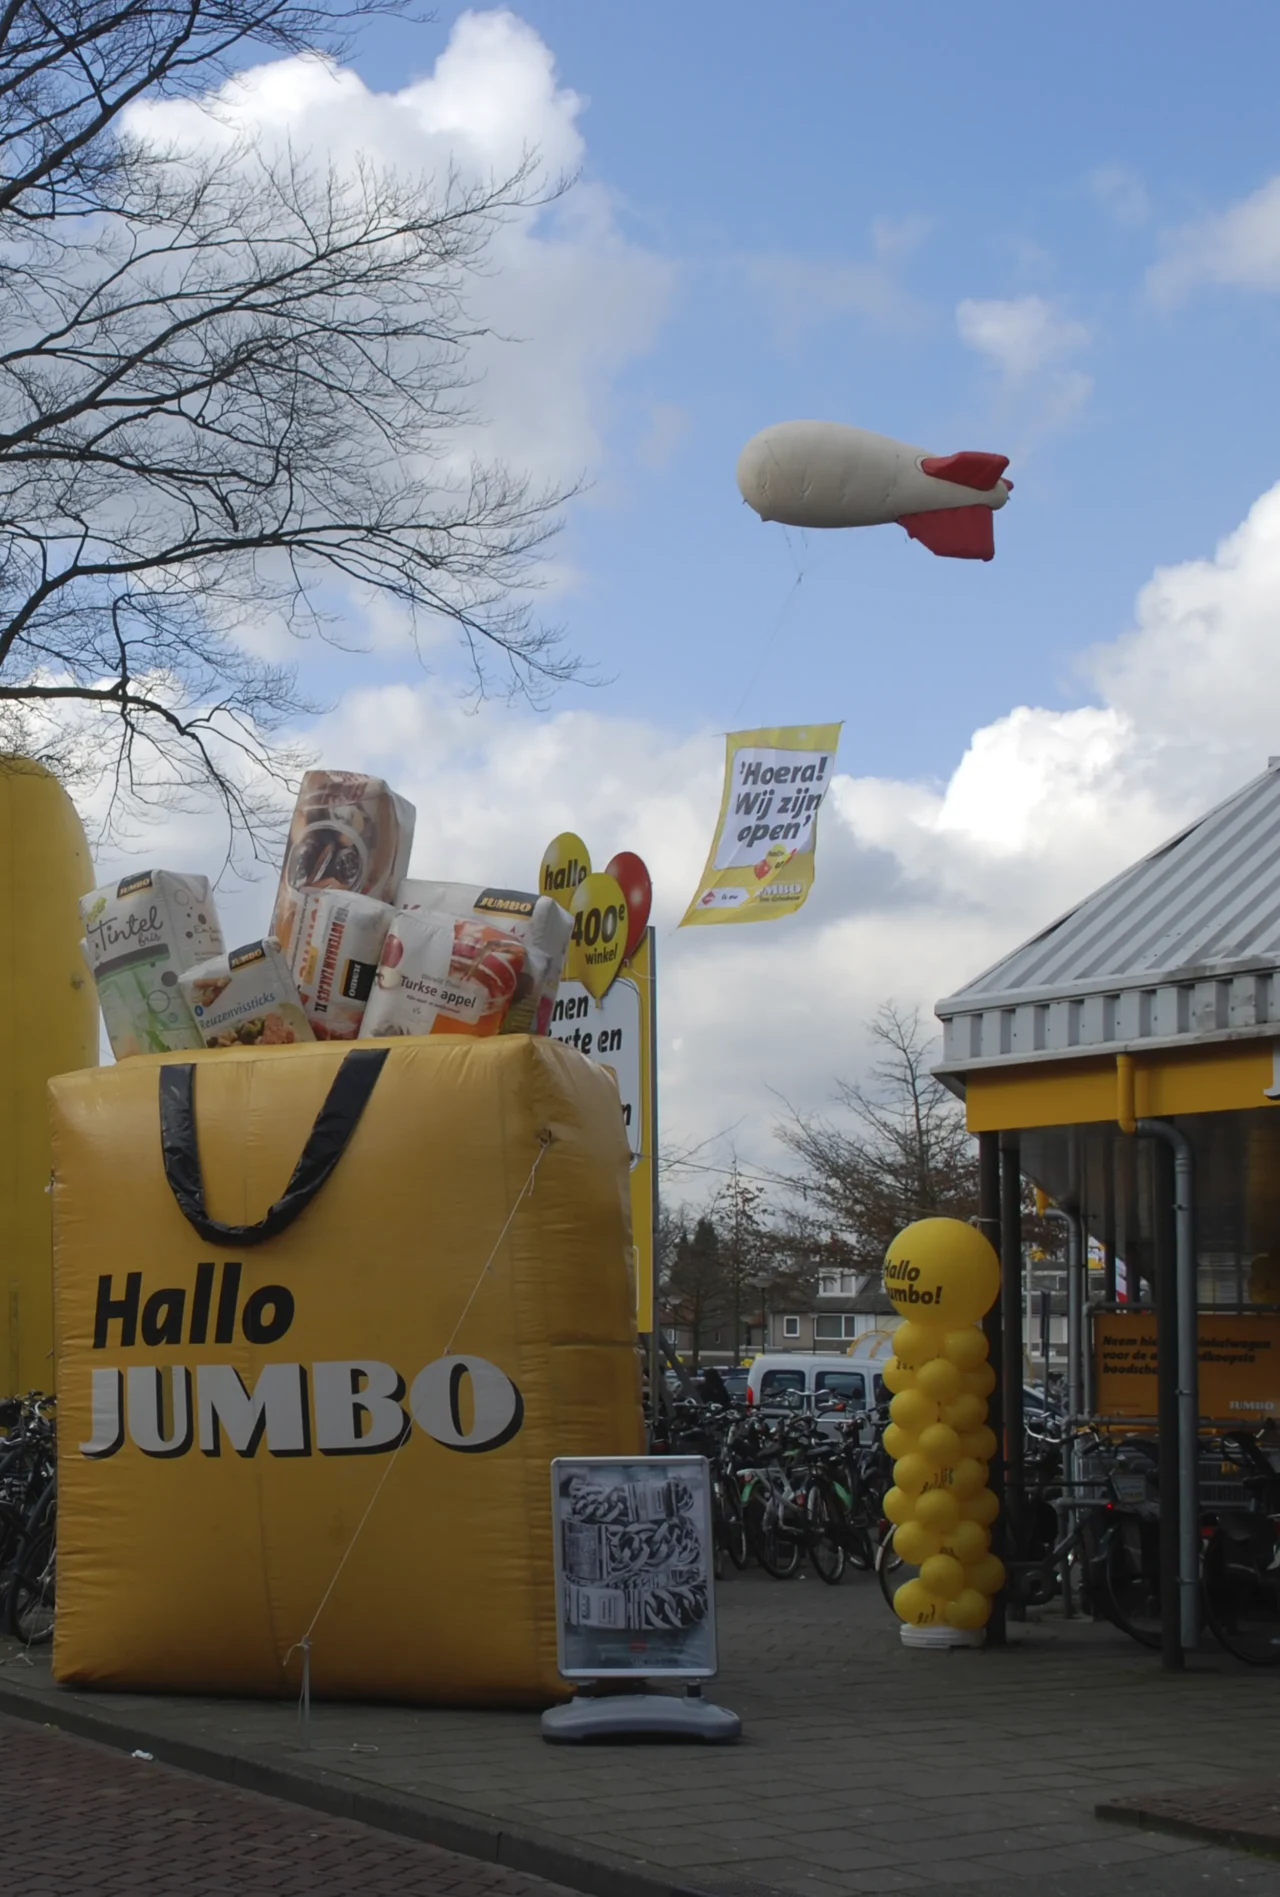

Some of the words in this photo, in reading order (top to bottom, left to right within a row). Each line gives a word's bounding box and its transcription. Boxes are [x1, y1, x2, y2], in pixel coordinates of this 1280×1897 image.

[735, 788, 775, 821] Wij
[776, 788, 822, 820] zijn
[119, 877, 150, 896] JUMBO
[544, 859, 588, 891] hallo
[479, 896, 532, 913] JUMBO
[87, 905, 164, 951] Tintel
[231, 948, 263, 967] JUMBO
[585, 943, 617, 965] winkel
[348, 963, 362, 997] JUMBO
[400, 975, 438, 997] Turkse
[440, 989, 477, 1009] appel
[199, 991, 276, 1029] Reuzenvissticks
[552, 995, 589, 1022] nen
[598, 1027, 622, 1054] en
[92, 1262, 295, 1349] Hallo
[887, 1284, 942, 1305] umbo!
[1102, 1335, 1137, 1347] Neem
[1197, 1336, 1271, 1352] inkelwagen
[1102, 1352, 1129, 1361] voor
[1131, 1349, 1147, 1361] de
[1198, 1350, 1256, 1366] dkoopste
[1102, 1363, 1158, 1374] boodscha
[78, 1354, 525, 1461] JUMBO
[1229, 1400, 1275, 1411] JUMBO
